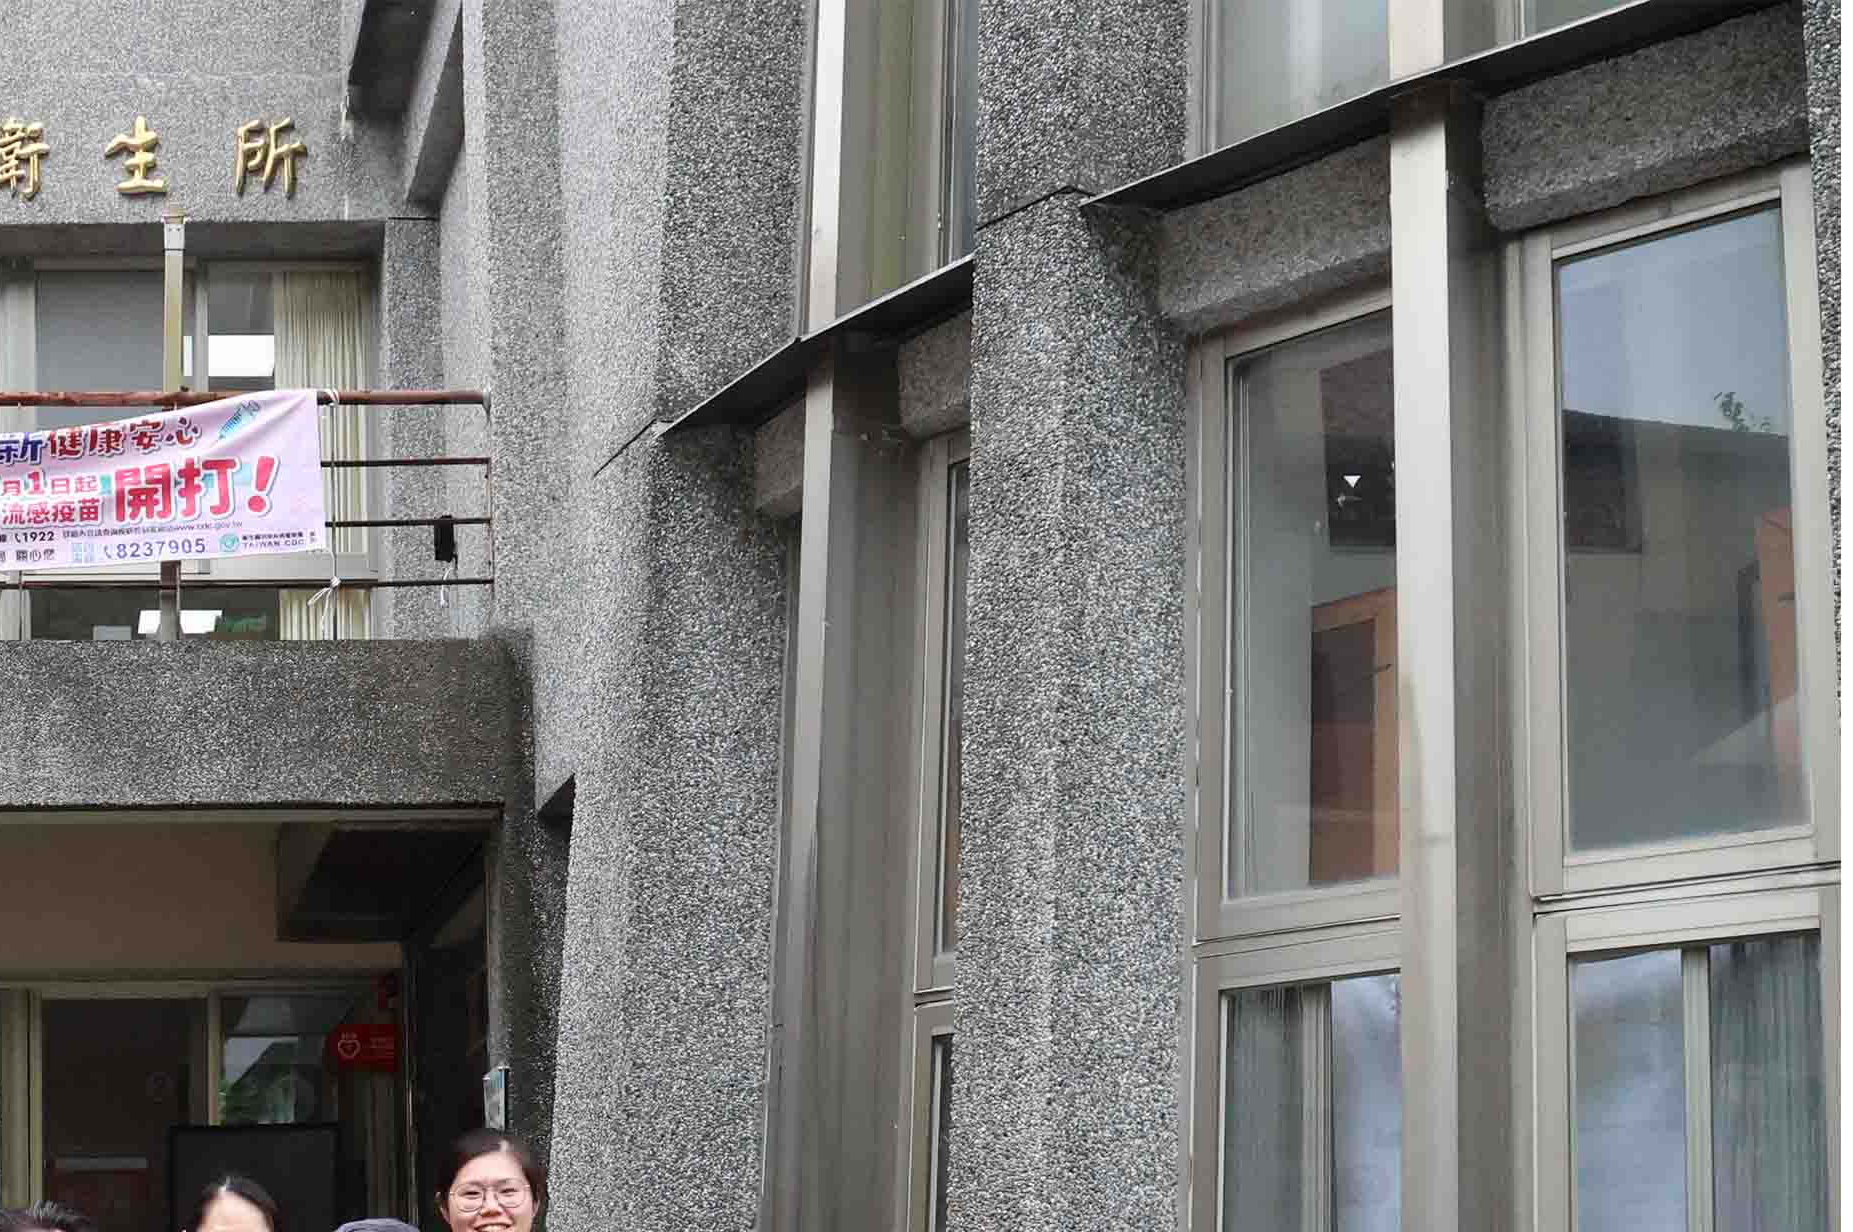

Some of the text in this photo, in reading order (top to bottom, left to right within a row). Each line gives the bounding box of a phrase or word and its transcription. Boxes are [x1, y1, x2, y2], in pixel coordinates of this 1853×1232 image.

[115, 455, 276, 524] 開打！
[23, 531, 55, 544] 1922
[116, 538, 206, 559] 8237905
